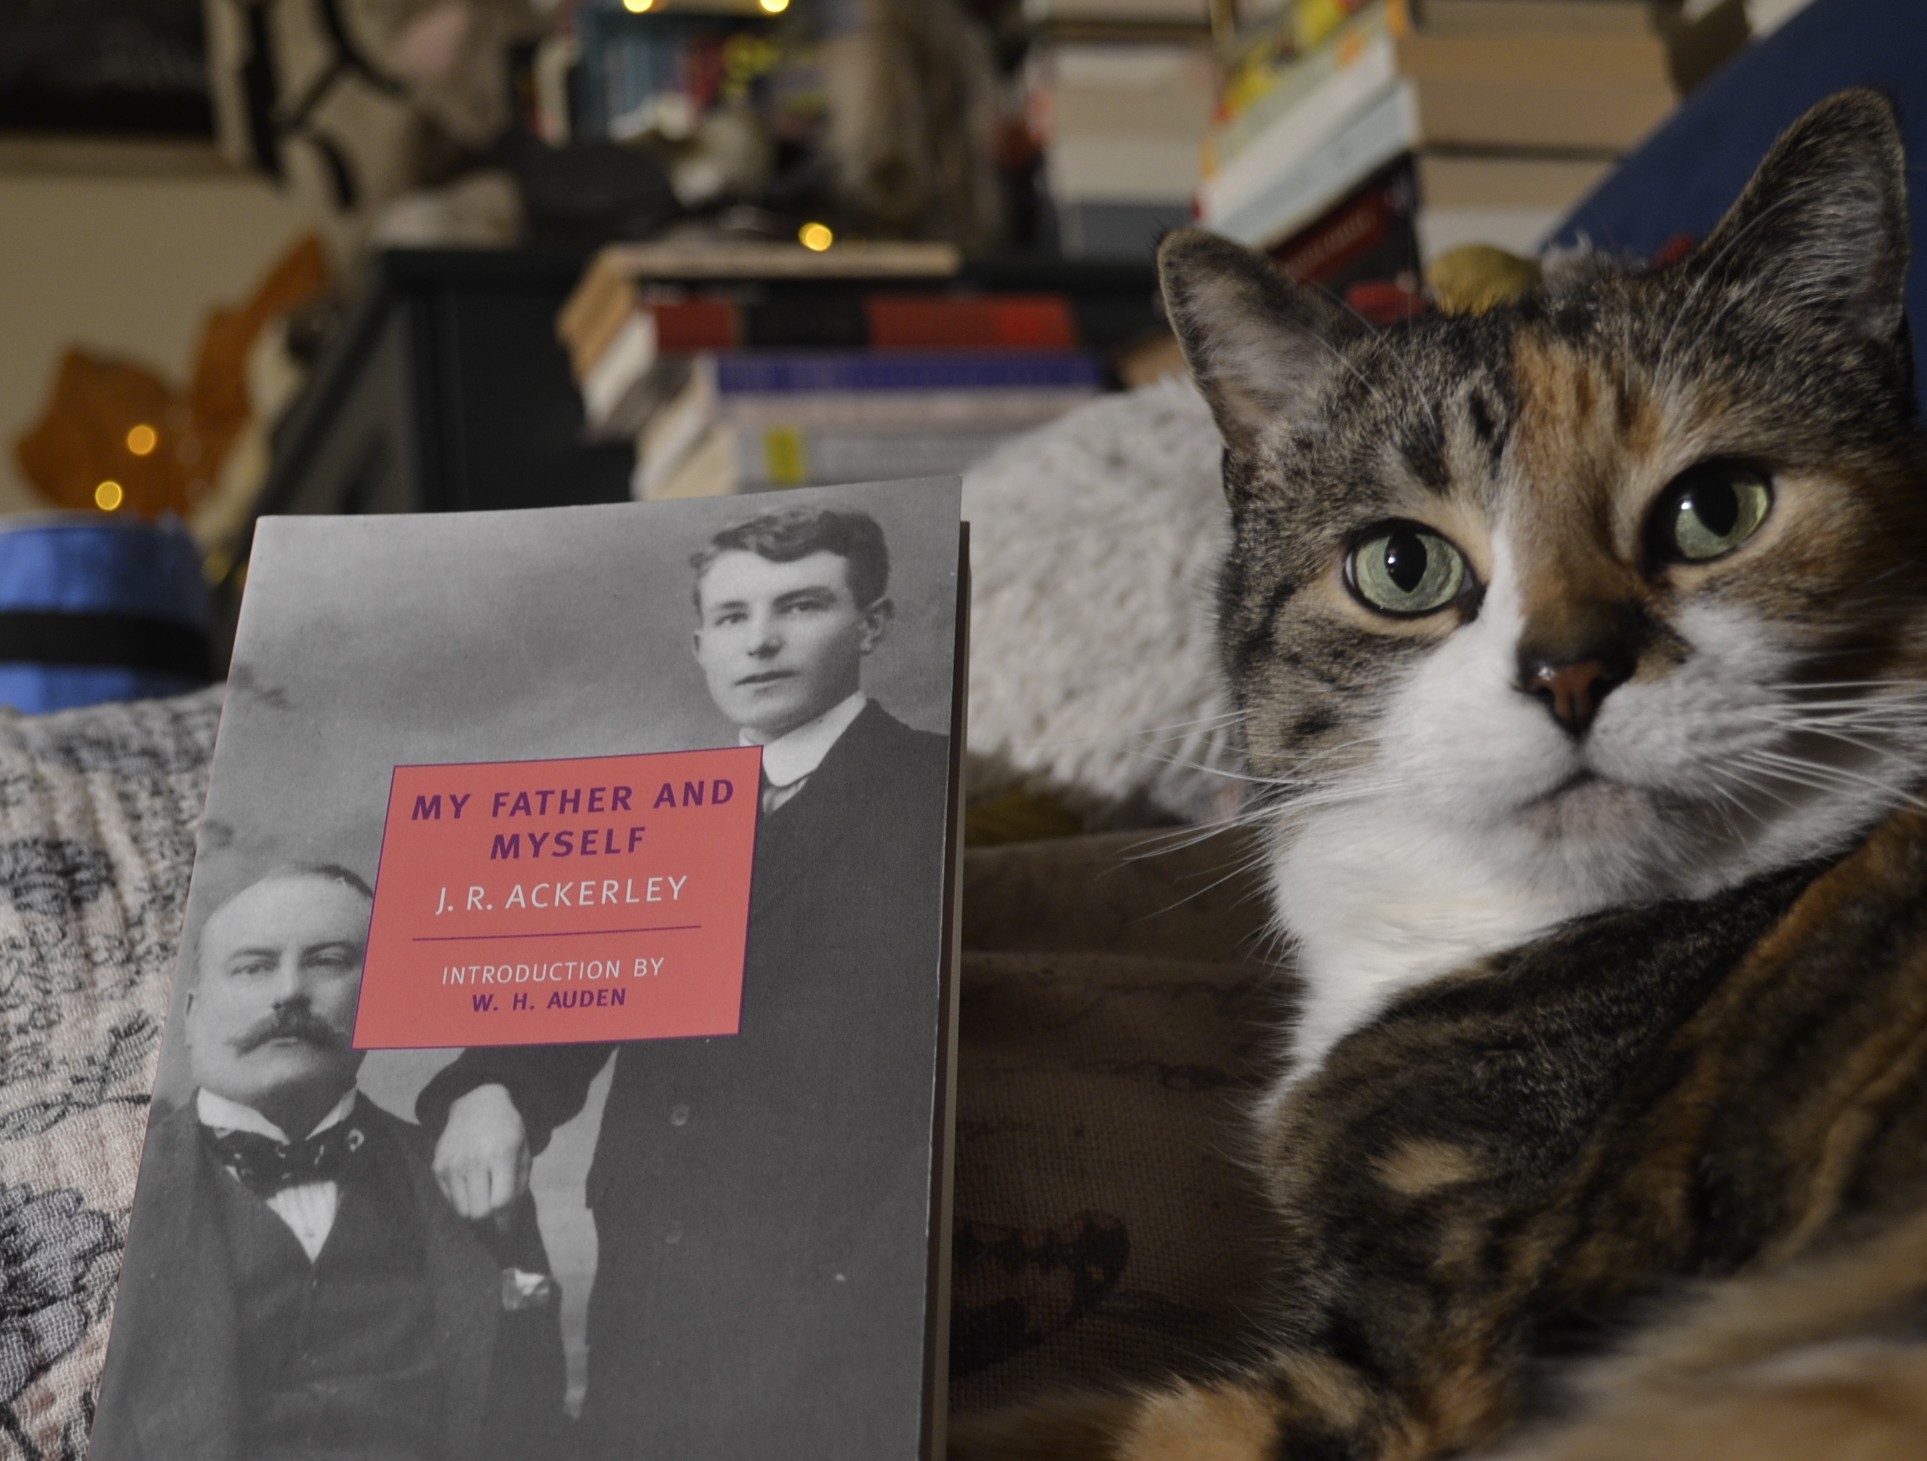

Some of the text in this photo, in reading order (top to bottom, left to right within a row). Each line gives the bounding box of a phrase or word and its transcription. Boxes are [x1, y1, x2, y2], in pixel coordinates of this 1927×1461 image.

[411, 778, 734, 821] MY FATHER AND
[490, 826, 646, 860] MYSELF
[435, 875, 688, 916] J. R. ACKERLEY
[442, 957, 665, 985] INTRODUCTION BY
[472, 988, 626, 1013] W. H. AUDEN
